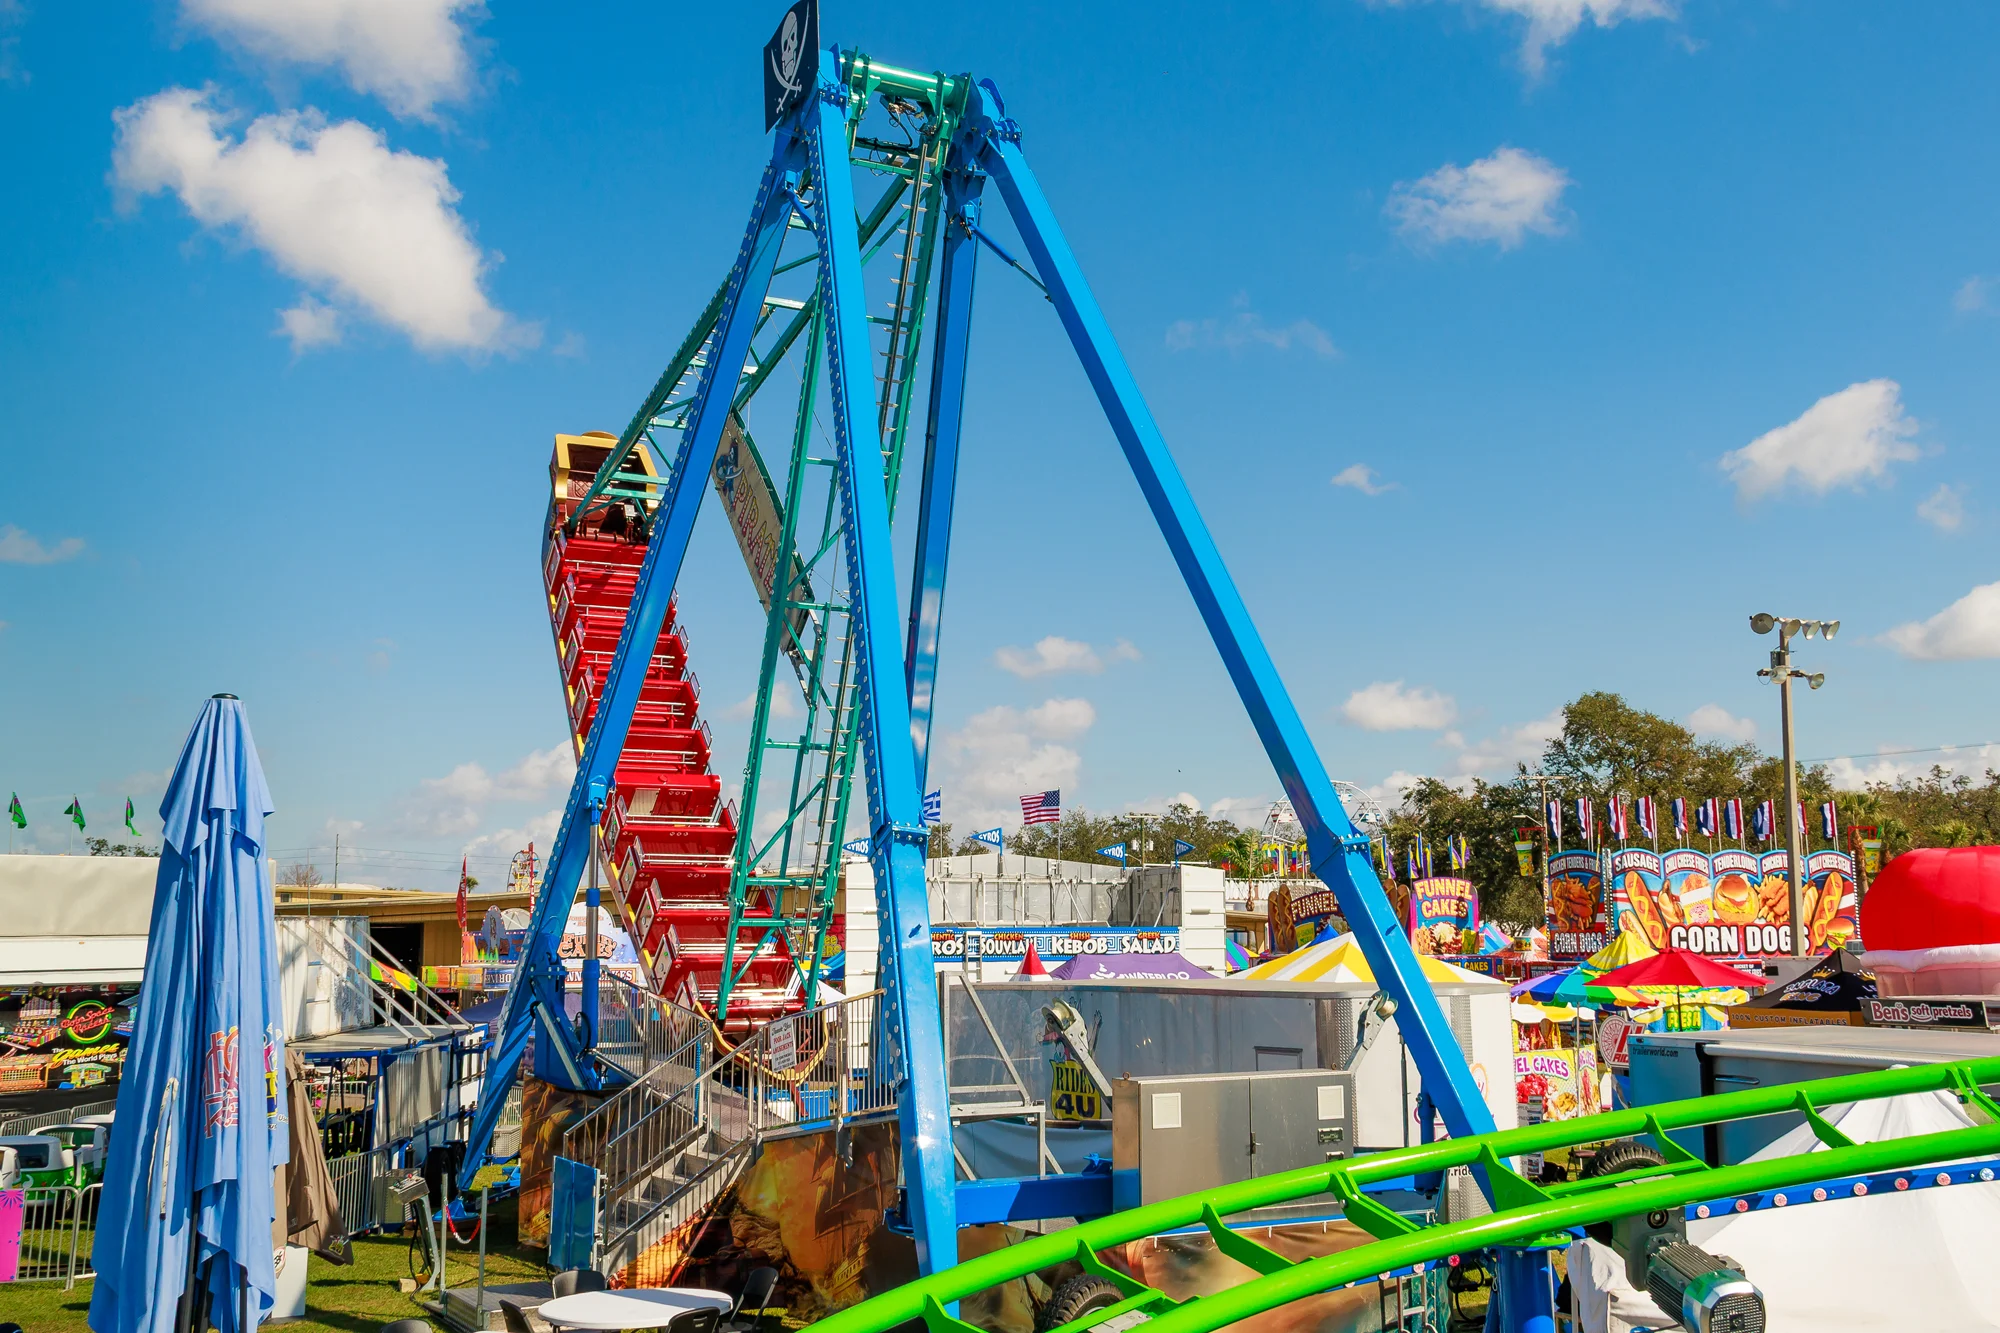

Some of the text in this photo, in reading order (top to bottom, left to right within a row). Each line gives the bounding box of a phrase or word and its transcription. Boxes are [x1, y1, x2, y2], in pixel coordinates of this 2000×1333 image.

[978, 830, 1000, 843] GYROS
[846, 840, 869, 854] GYROS
[1103, 845, 1123, 859] GYROS
[1549, 858, 1566, 875] CHICKEN
[1566, 856, 1584, 869] TENDERS
[1615, 853, 1659, 873] SAUSAGE
[1677, 853, 1695, 868] CHEESE
[1414, 878, 1473, 901] FUNNEL
[1290, 891, 1338, 922] FUNNEL
[1421, 898, 1468, 919] CAKES
[994, 933, 1024, 941] CHICKEN
[1051, 935, 1108, 954] KEBOB
[1069, 932, 1091, 940] SHISH
[1121, 935, 1176, 954] SALAD
[1553, 932, 1603, 954] CORN DOGS
[1670, 925, 1739, 953] CORN
[1731, 1013, 1847, 1026] 100% CUSTOM INFLATABLES
[1871, 1001, 1972, 1021] Ben's soft pretzels
[62, 1052, 118, 1066] The World Plays
[1632, 1046, 1679, 1057] trailerworld.com
[1533, 1055, 1569, 1077] CAKES
[1055, 1094, 1096, 1118] 4U
